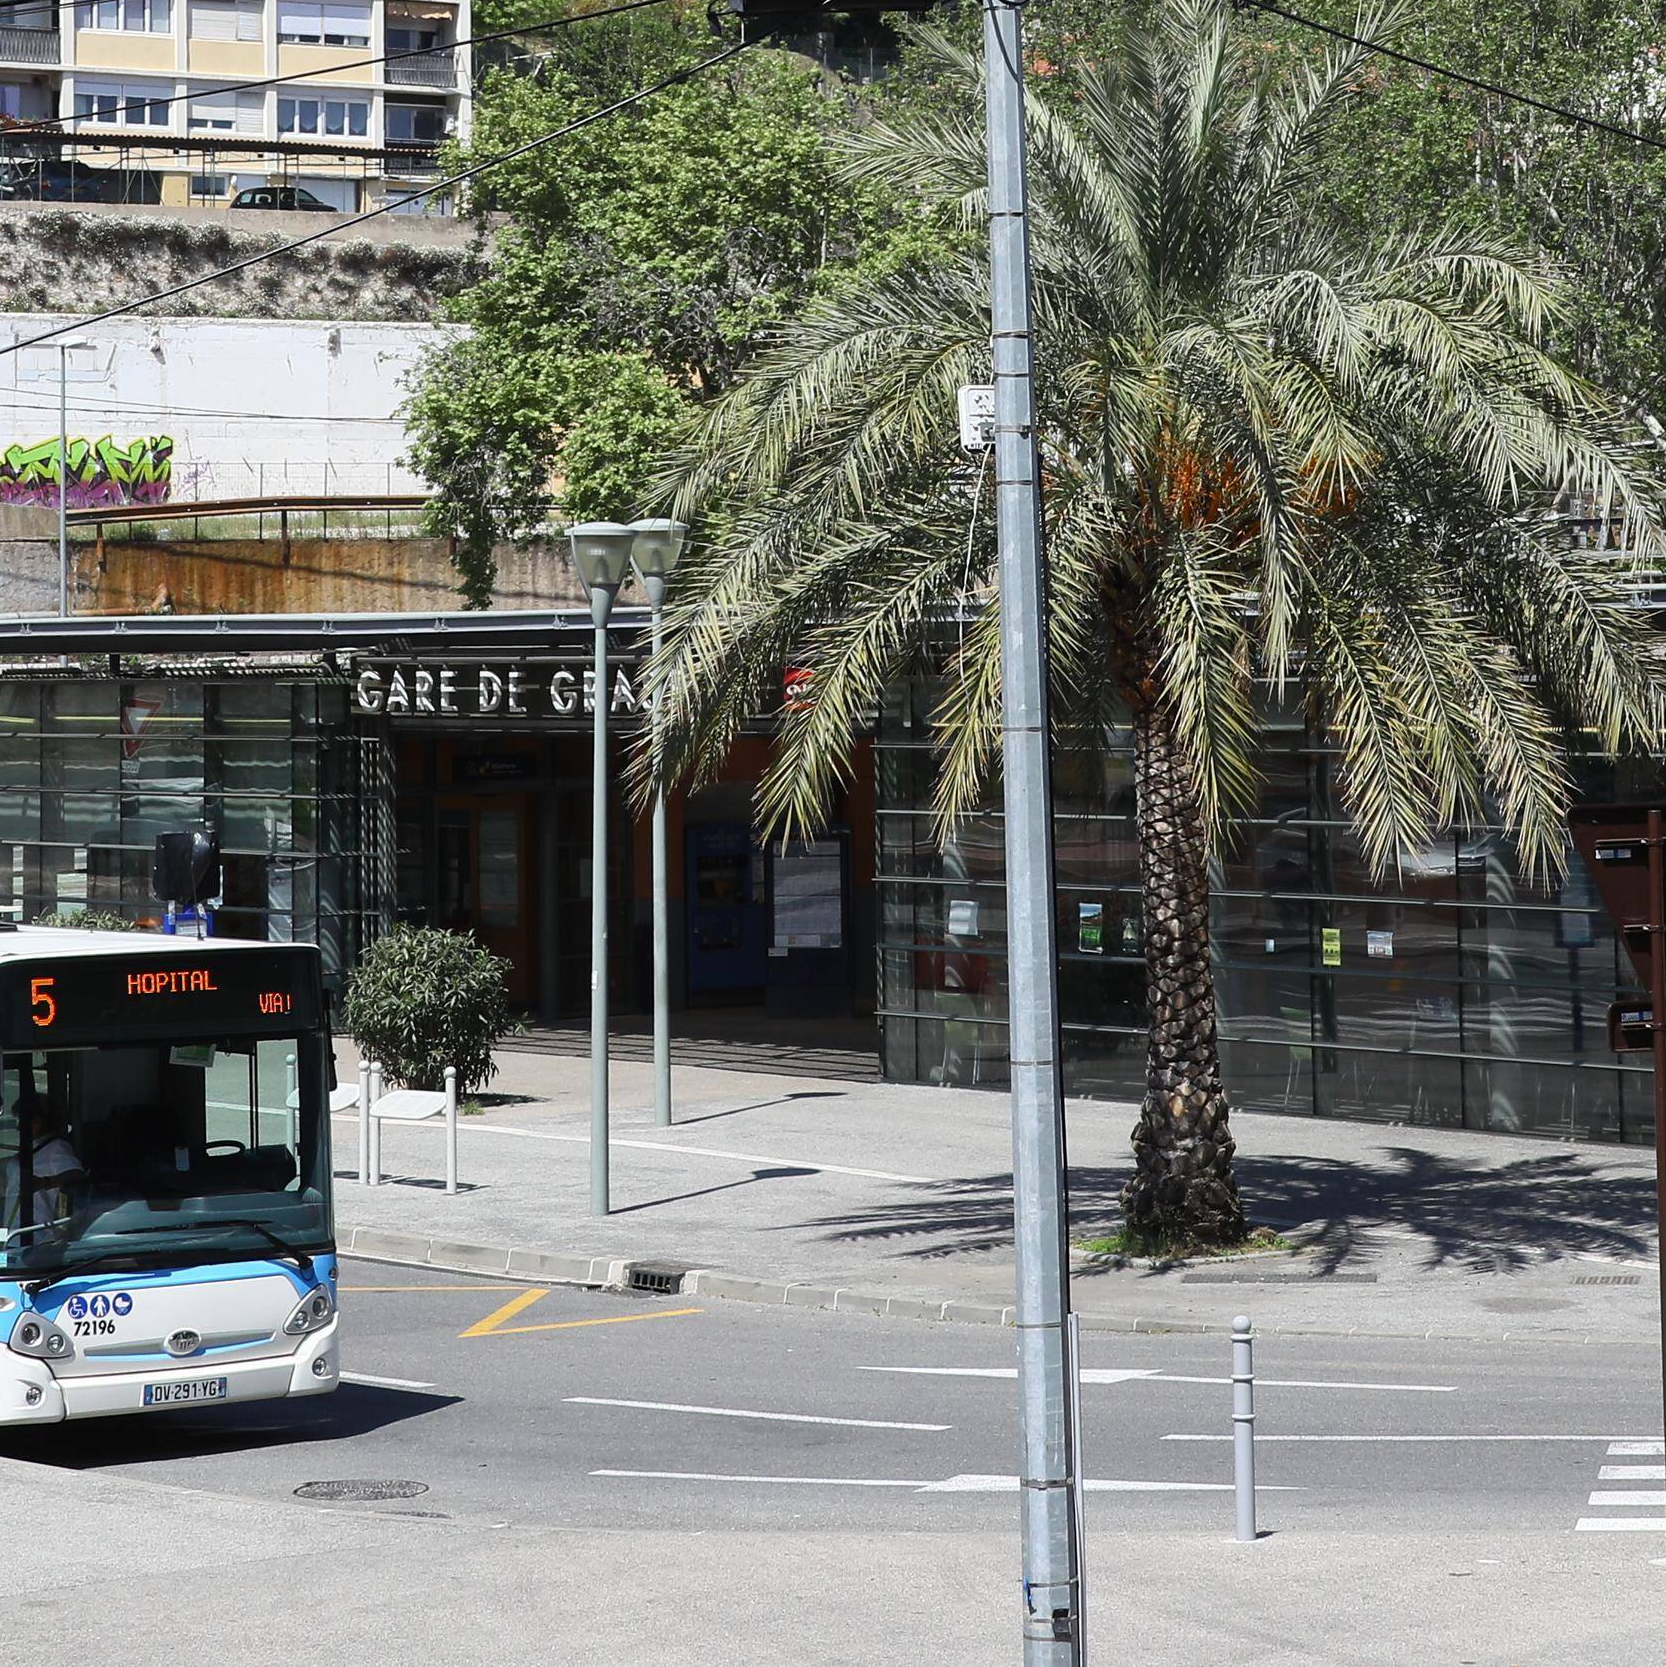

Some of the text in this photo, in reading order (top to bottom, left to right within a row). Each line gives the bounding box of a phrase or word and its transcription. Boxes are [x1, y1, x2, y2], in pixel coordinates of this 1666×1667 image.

[357, 670, 459, 714] GARE
[479, 670, 527, 713] DE
[127, 970, 218, 995] HOPITAL
[31, 977, 57, 1027] 5
[74, 1319, 116, 1337] 72196
